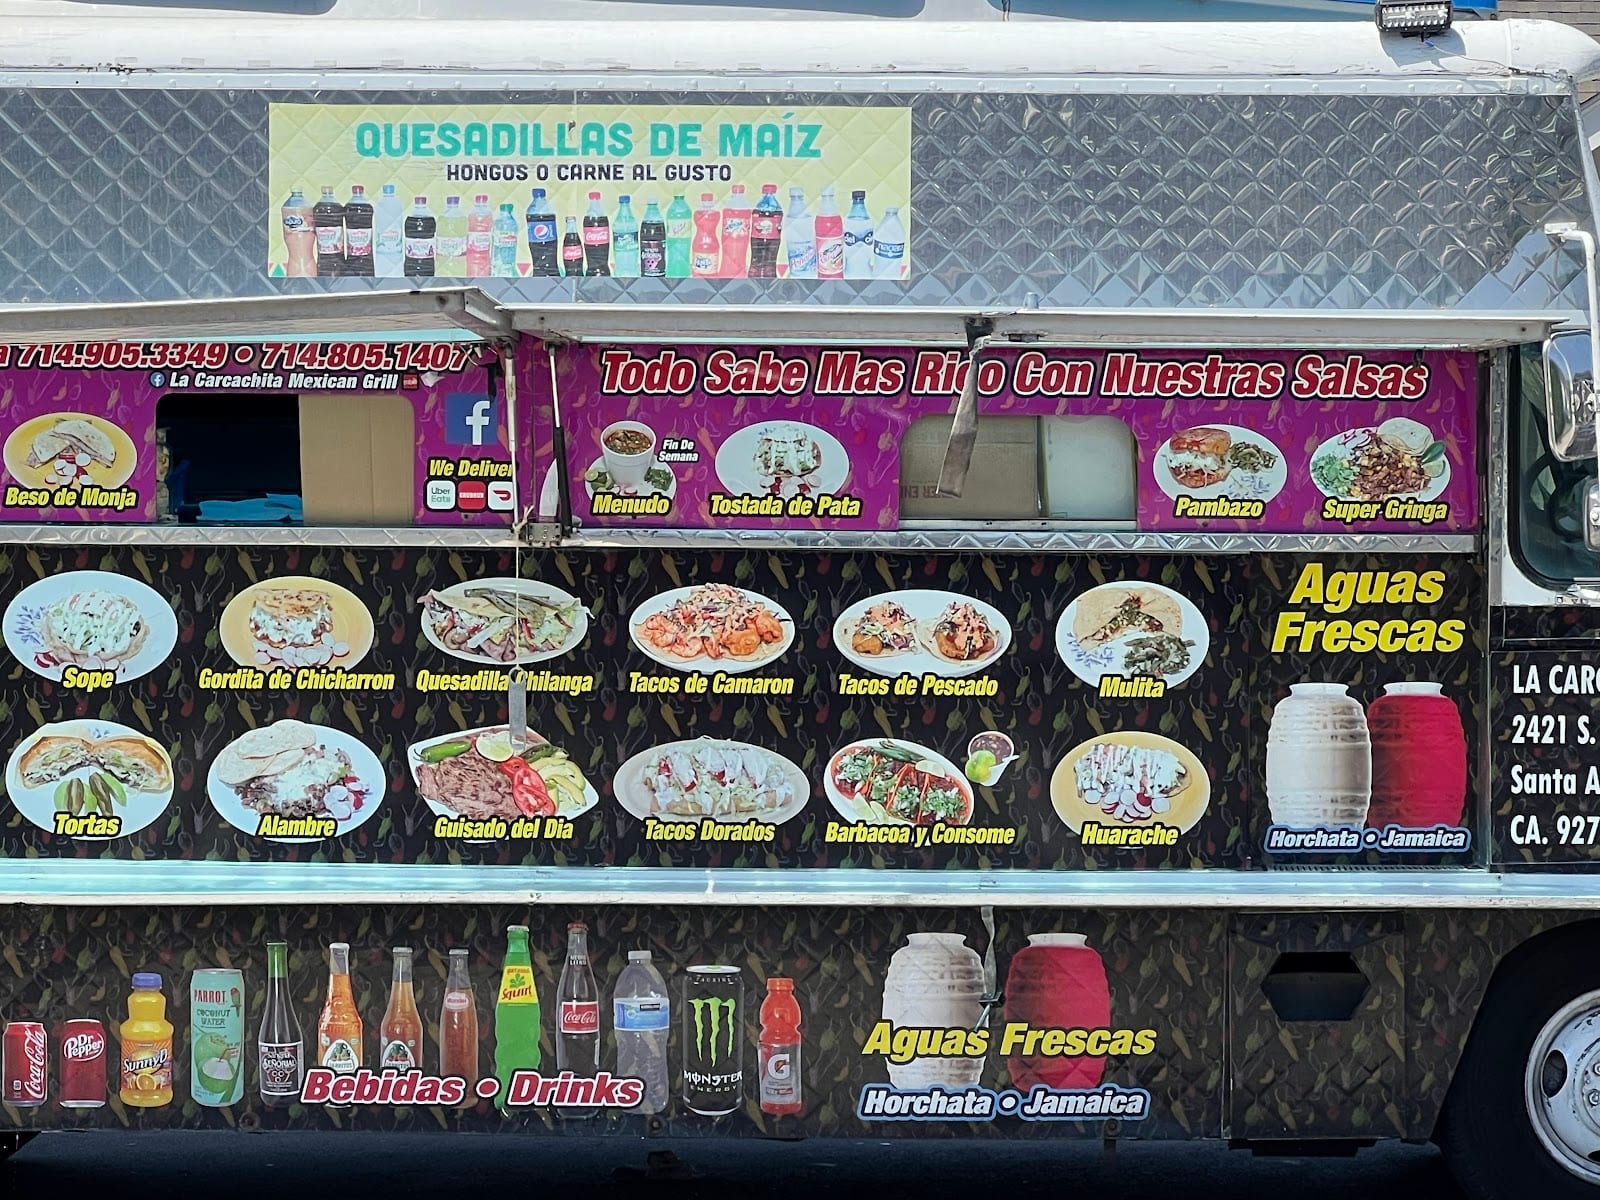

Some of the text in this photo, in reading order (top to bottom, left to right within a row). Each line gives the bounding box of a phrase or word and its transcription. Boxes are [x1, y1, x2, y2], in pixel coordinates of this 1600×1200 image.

[356, 112, 823, 158] QUESADILLAS DE MAÍZ
[447, 164, 732, 181] HONGOS O CARNE AL GUSTO
[18, 342, 229, 368] 714.905.3349
[261, 342, 472, 371] 714.805.1407
[170, 372, 398, 389] La Carcachita Mexican Grill
[602, 350, 696, 393] Todo
[704, 350, 807, 394] Sabe
[815, 350, 904, 394] Mas
[1013, 352, 1095, 396] Con
[1100, 352, 1285, 398] Nuestras
[1290, 353, 1428, 398] Salsas
[658, 450, 699, 461] Semana
[663, 439, 695, 450] Fin De
[430, 459, 454, 476] We
[6, 487, 137, 511] Beso de Monja
[592, 495, 670, 515] Menudo
[711, 495, 861, 516] Tostada de Pata
[1175, 497, 1264, 518] Pambazo
[1323, 499, 1448, 524] Super Gringa
[1288, 562, 1446, 613] Aguas
[1271, 612, 1466, 654] Frescas
[63, 669, 115, 692] Sope
[199, 669, 395, 691] Gordita de Chicharron
[416, 669, 509, 692] Quesadilla
[629, 672, 795, 695] Tacos de Camaron
[838, 674, 999, 697] Tacos de Pescado
[1099, 677, 1165, 698] Mulita
[1512, 664, 1542, 694] LA
[1511, 714, 1596, 745] 2421 S.
[1510, 764, 1577, 795] Santa
[55, 814, 119, 836] Tortas
[258, 815, 336, 837] Alambre
[434, 816, 574, 840] Guisado del Dia
[645, 819, 775, 842] Tacos Dorados
[825, 822, 1016, 848] Barbacoa y Consome
[1081, 824, 1179, 846] Huarache
[1510, 815, 1548, 845] CA.
[1269, 829, 1466, 849] Horchata Jamaica
[194, 989, 227, 1003] PARROT
[502, 985, 532, 1000] Squirt
[197, 1009, 230, 1017] COCONUT
[201, 1018, 225, 1026] WATER
[67, 1037, 102, 1059] Pepper
[78, 1034, 94, 1046] Dr
[861, 1022, 1156, 1063] Aguas Frescas
[767, 1053, 790, 1080] G
[301, 1068, 645, 1108] Bebidas Drinks
[684, 1070, 742, 1086] MONSTER
[690, 1085, 737, 1093] ENERGY
[863, 1090, 1144, 1115] Horchata Jamaica
